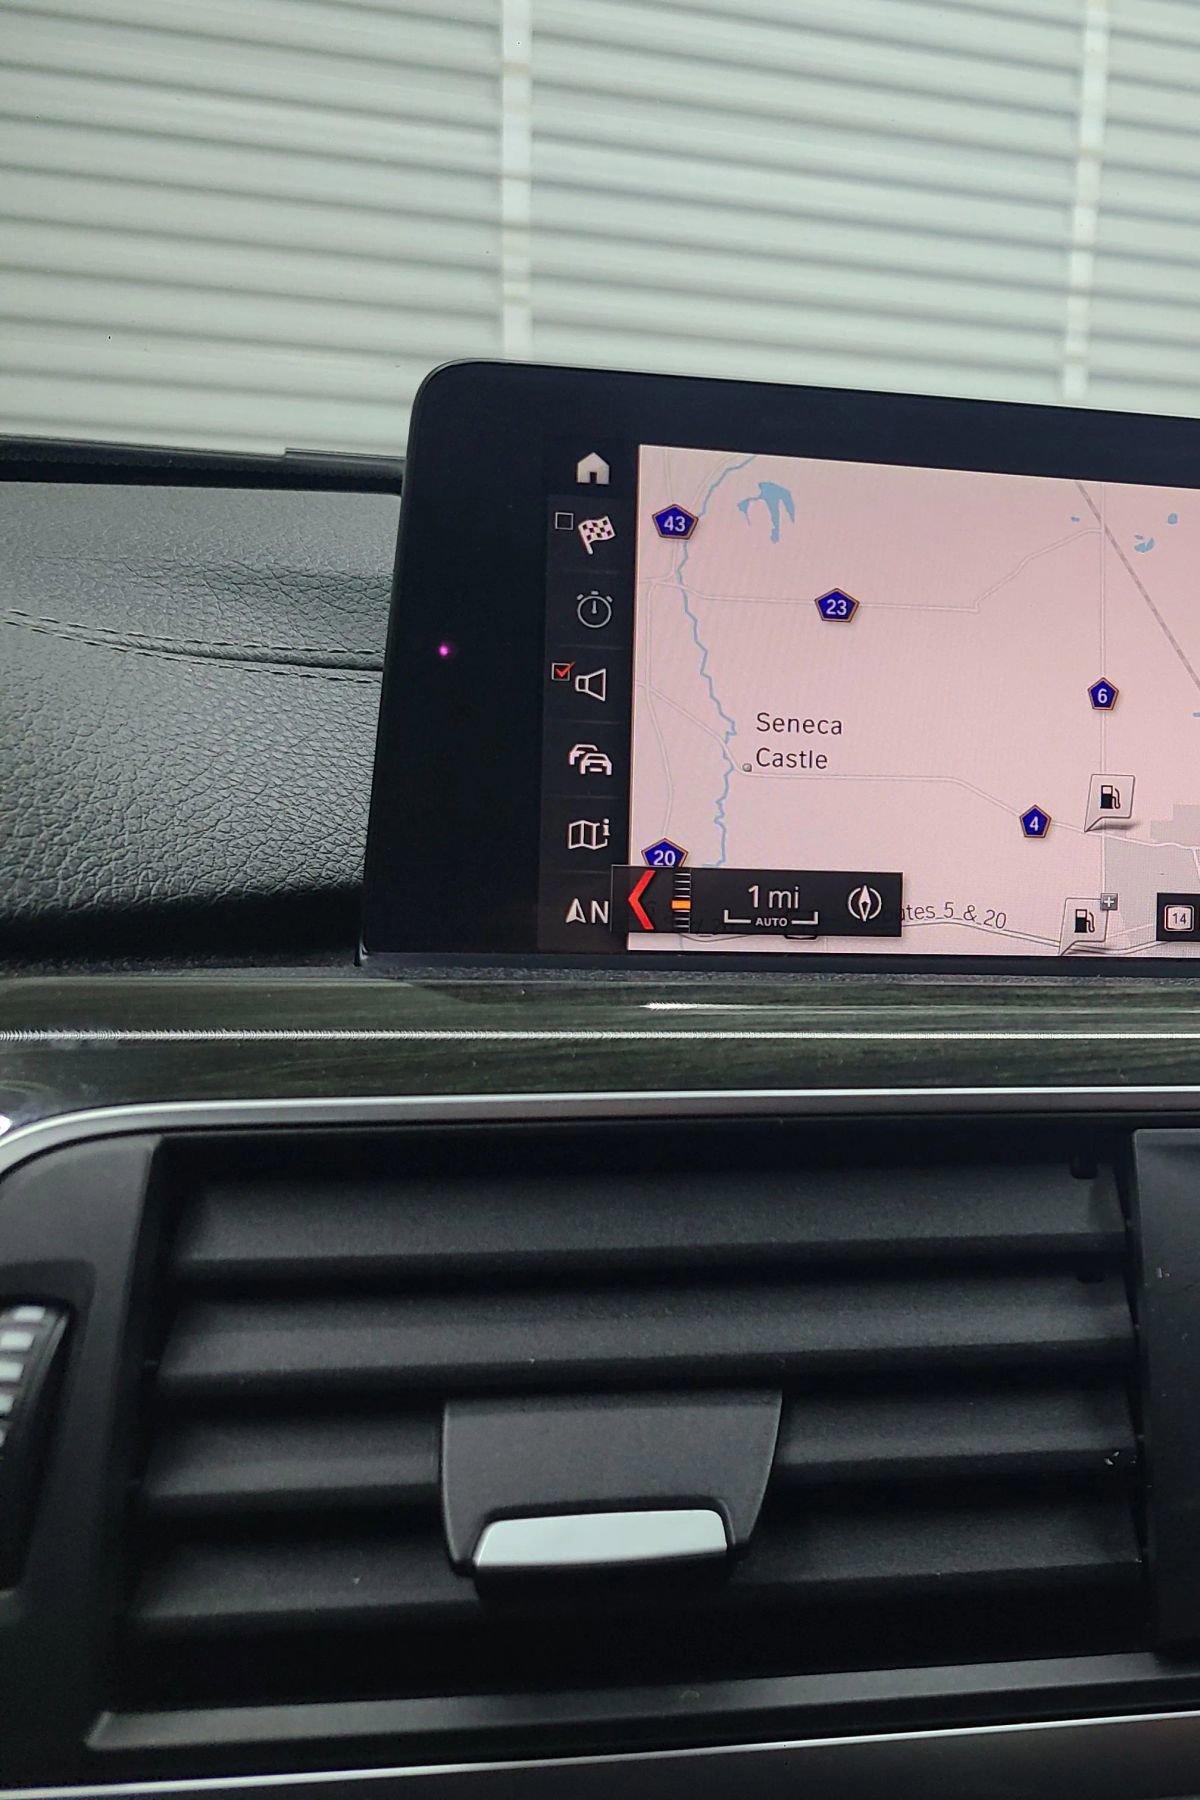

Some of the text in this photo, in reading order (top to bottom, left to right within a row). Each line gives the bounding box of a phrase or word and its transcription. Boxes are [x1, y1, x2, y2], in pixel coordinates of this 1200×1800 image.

[664, 515, 686, 532] 43
[826, 599, 847, 616] 23
[1098, 688, 1108, 704] 6
[756, 712, 843, 736] Seneca
[756, 748, 829, 769] Castle
[1029, 815, 1041, 831] 4
[654, 850, 676, 866] 20
[748, 885, 799, 909] 1 mi
[591, 900, 609, 924] N
[943, 901, 954, 919] 5
[963, 904, 978, 922] &
[983, 909, 1007, 929] 20
[1172, 913, 1187, 925] 14
[755, 917, 788, 928] AUTO
